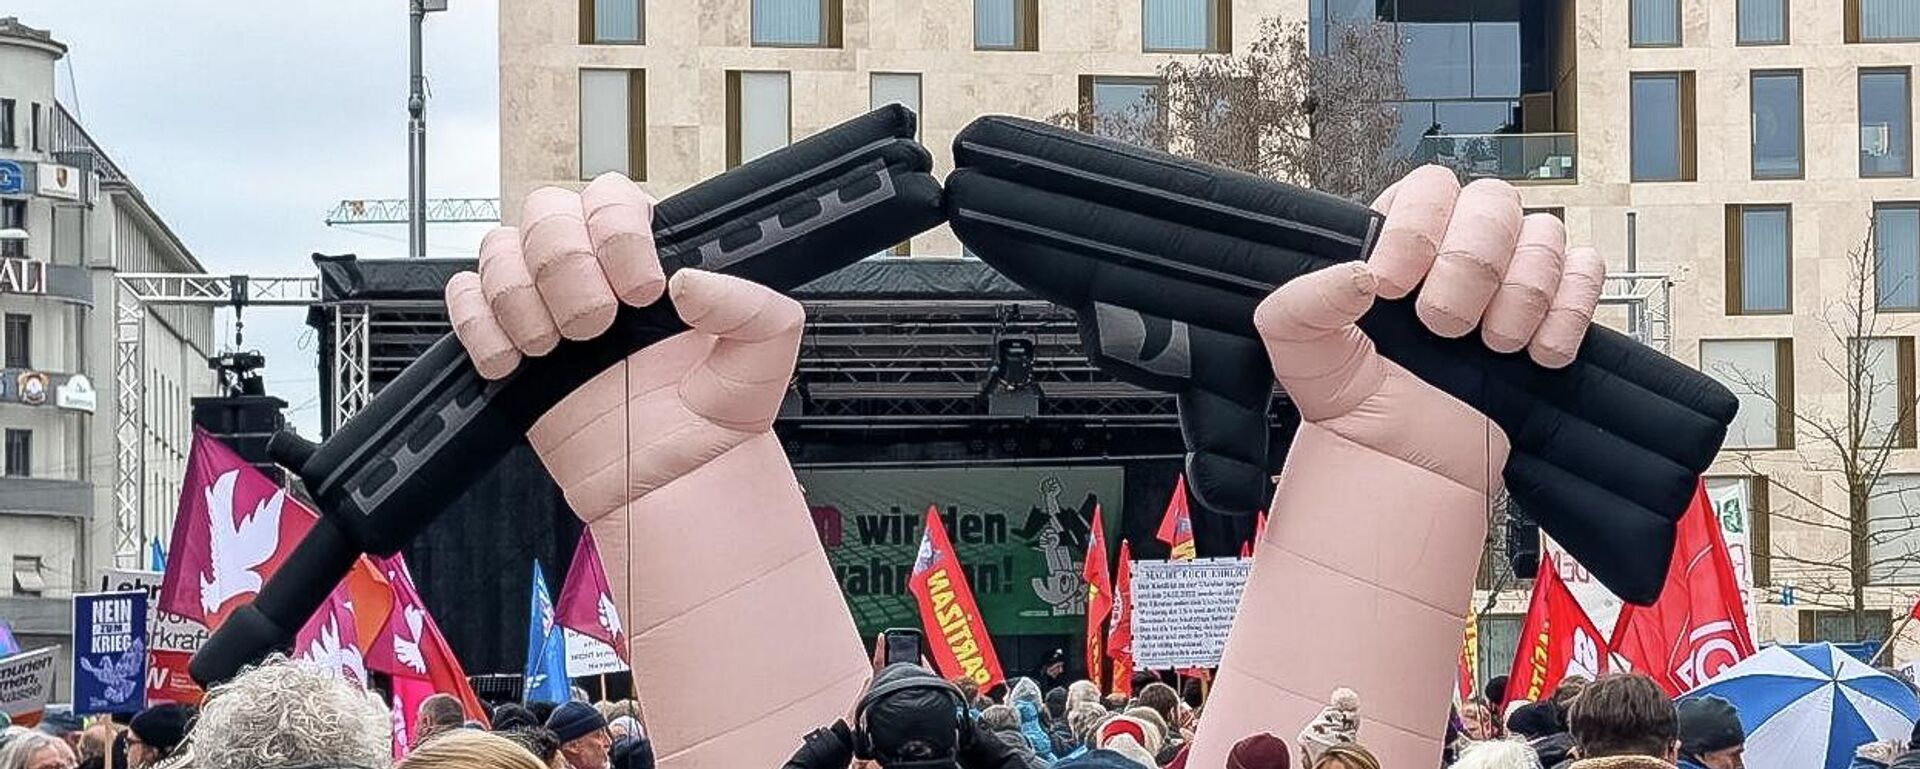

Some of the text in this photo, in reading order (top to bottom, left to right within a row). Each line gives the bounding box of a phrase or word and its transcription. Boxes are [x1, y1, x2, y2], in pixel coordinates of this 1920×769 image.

[856, 506, 921, 545] wir
[92, 599, 132, 623] NEIN
[100, 624, 122, 634] ZUM
[91, 634, 132, 653] KRIEG
